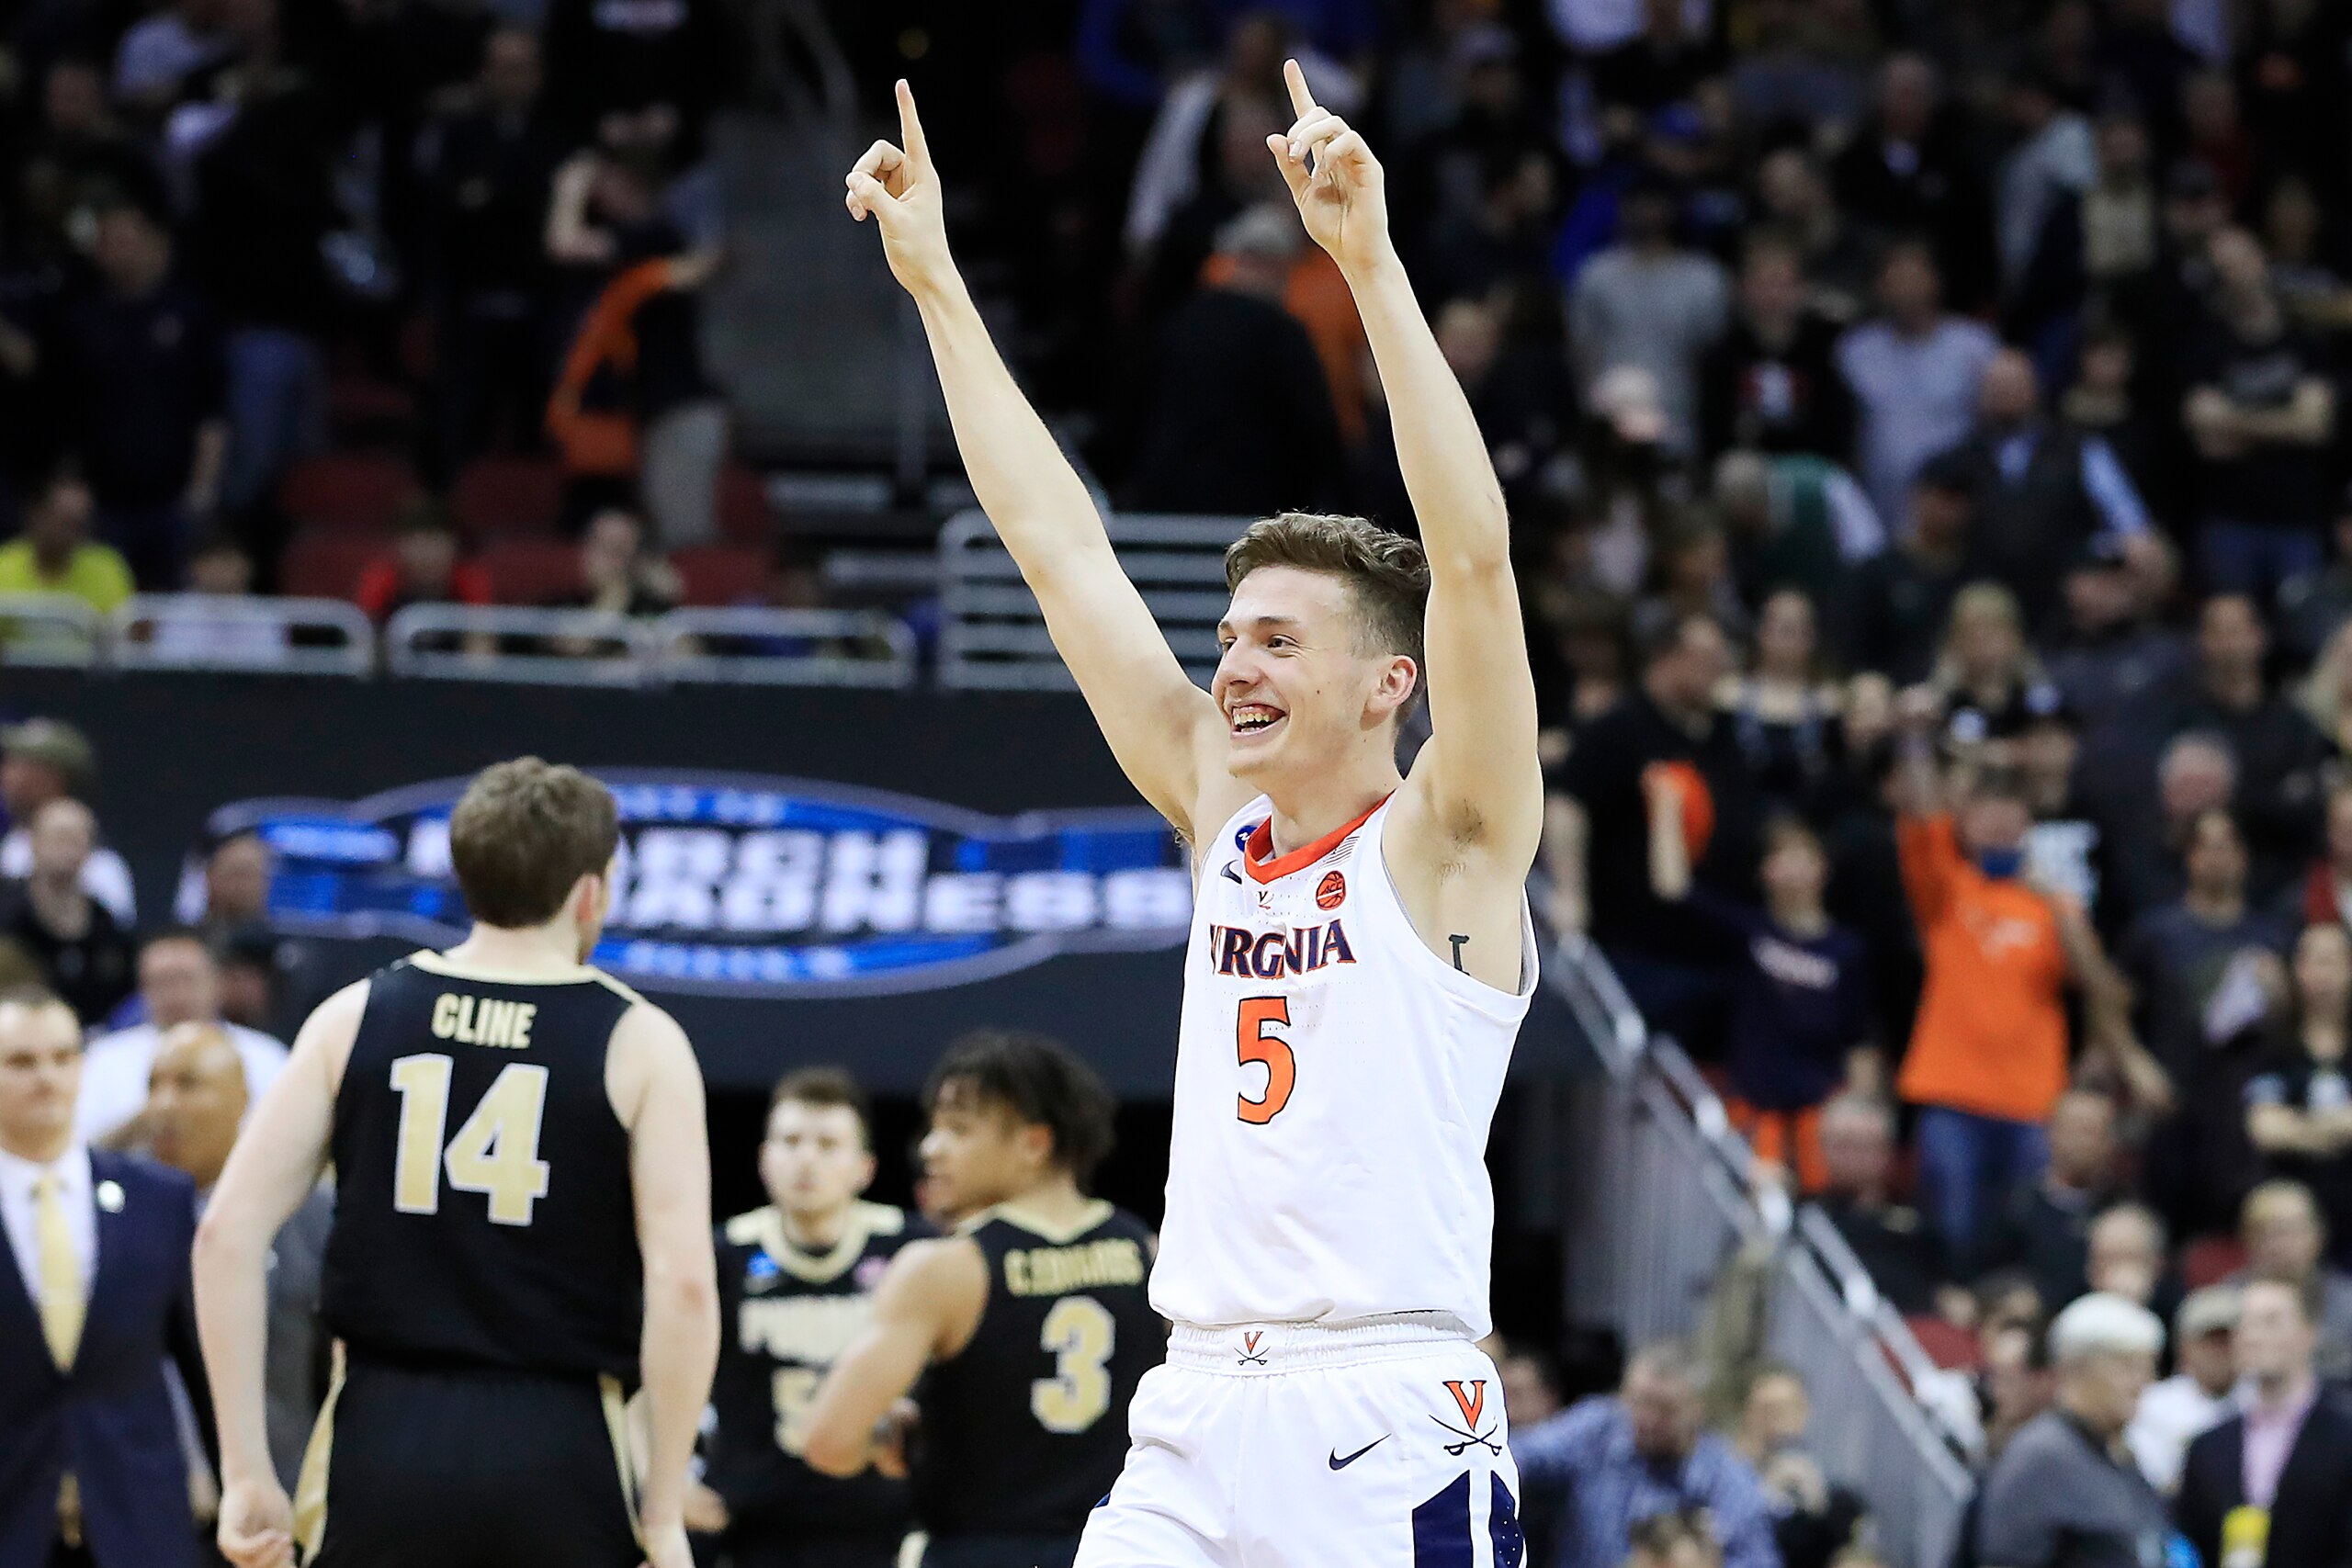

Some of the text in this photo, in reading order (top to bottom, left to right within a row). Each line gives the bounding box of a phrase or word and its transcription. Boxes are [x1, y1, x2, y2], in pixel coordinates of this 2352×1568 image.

[431, 992, 537, 1050] CLINE
[1237, 996, 1295, 1125] 5
[390, 1053, 550, 1226] 14
[1032, 1297, 1116, 1433] 3
[1243, 1330, 1263, 1355] V
[1442, 1380, 1487, 1432] V
